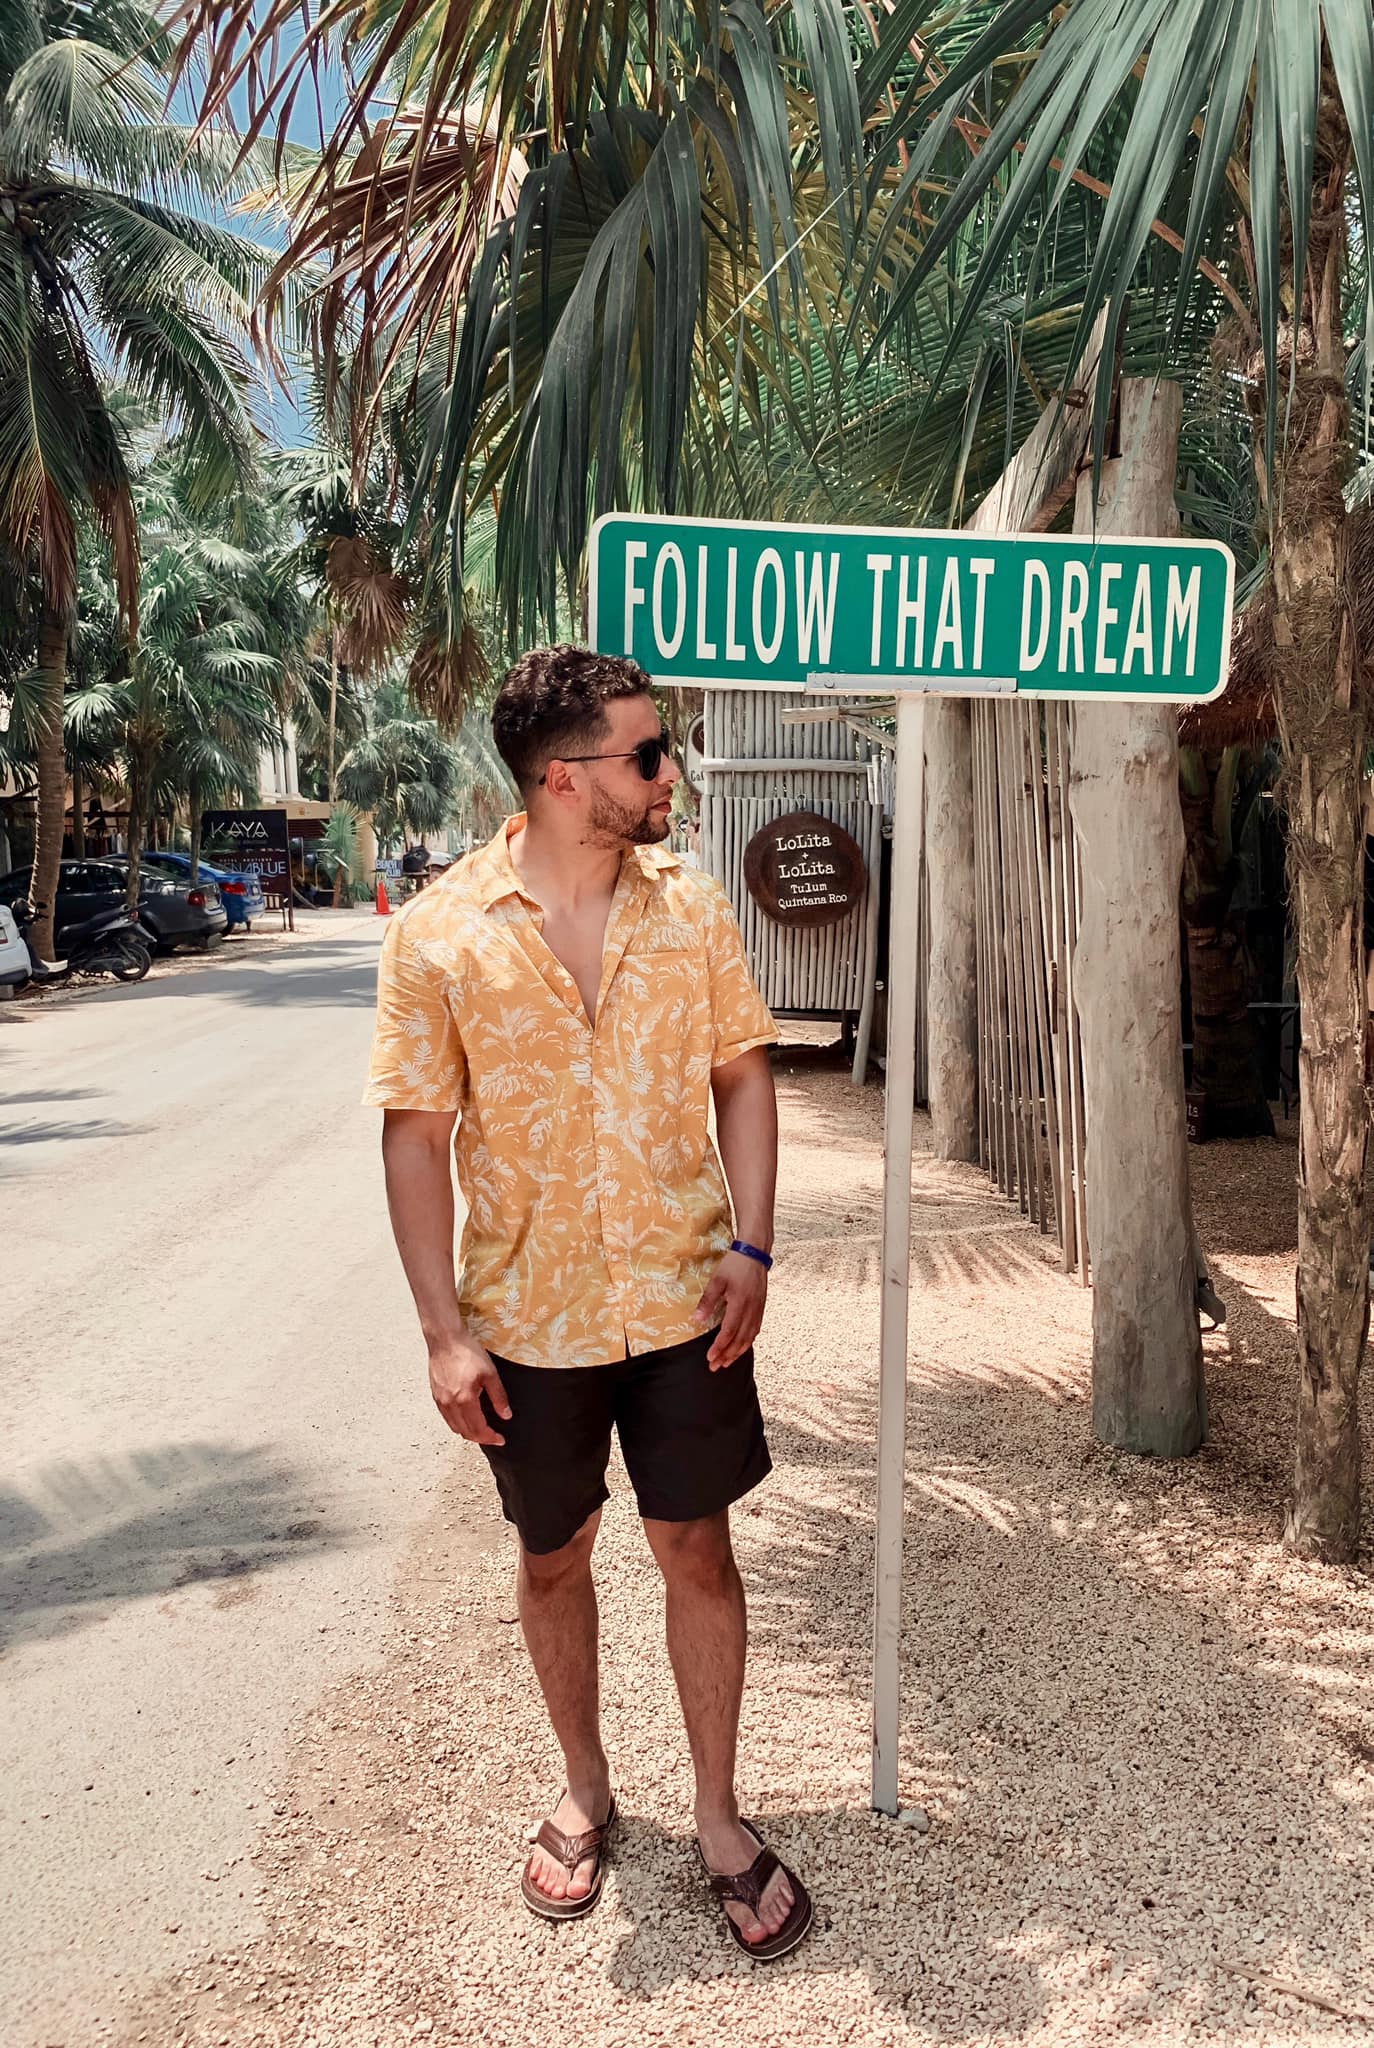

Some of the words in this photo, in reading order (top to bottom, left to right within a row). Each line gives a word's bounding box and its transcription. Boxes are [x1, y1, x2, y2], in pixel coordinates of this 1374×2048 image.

[624, 540, 841, 666] FOLLOW
[866, 553, 995, 670] THAT
[1018, 557, 1202, 677] DREAM
[211, 821, 269, 839] KAYA
[790, 882, 828, 894] Tulum
[778, 896, 827, 910] Quintana
[828, 893, 848, 904] Roo
